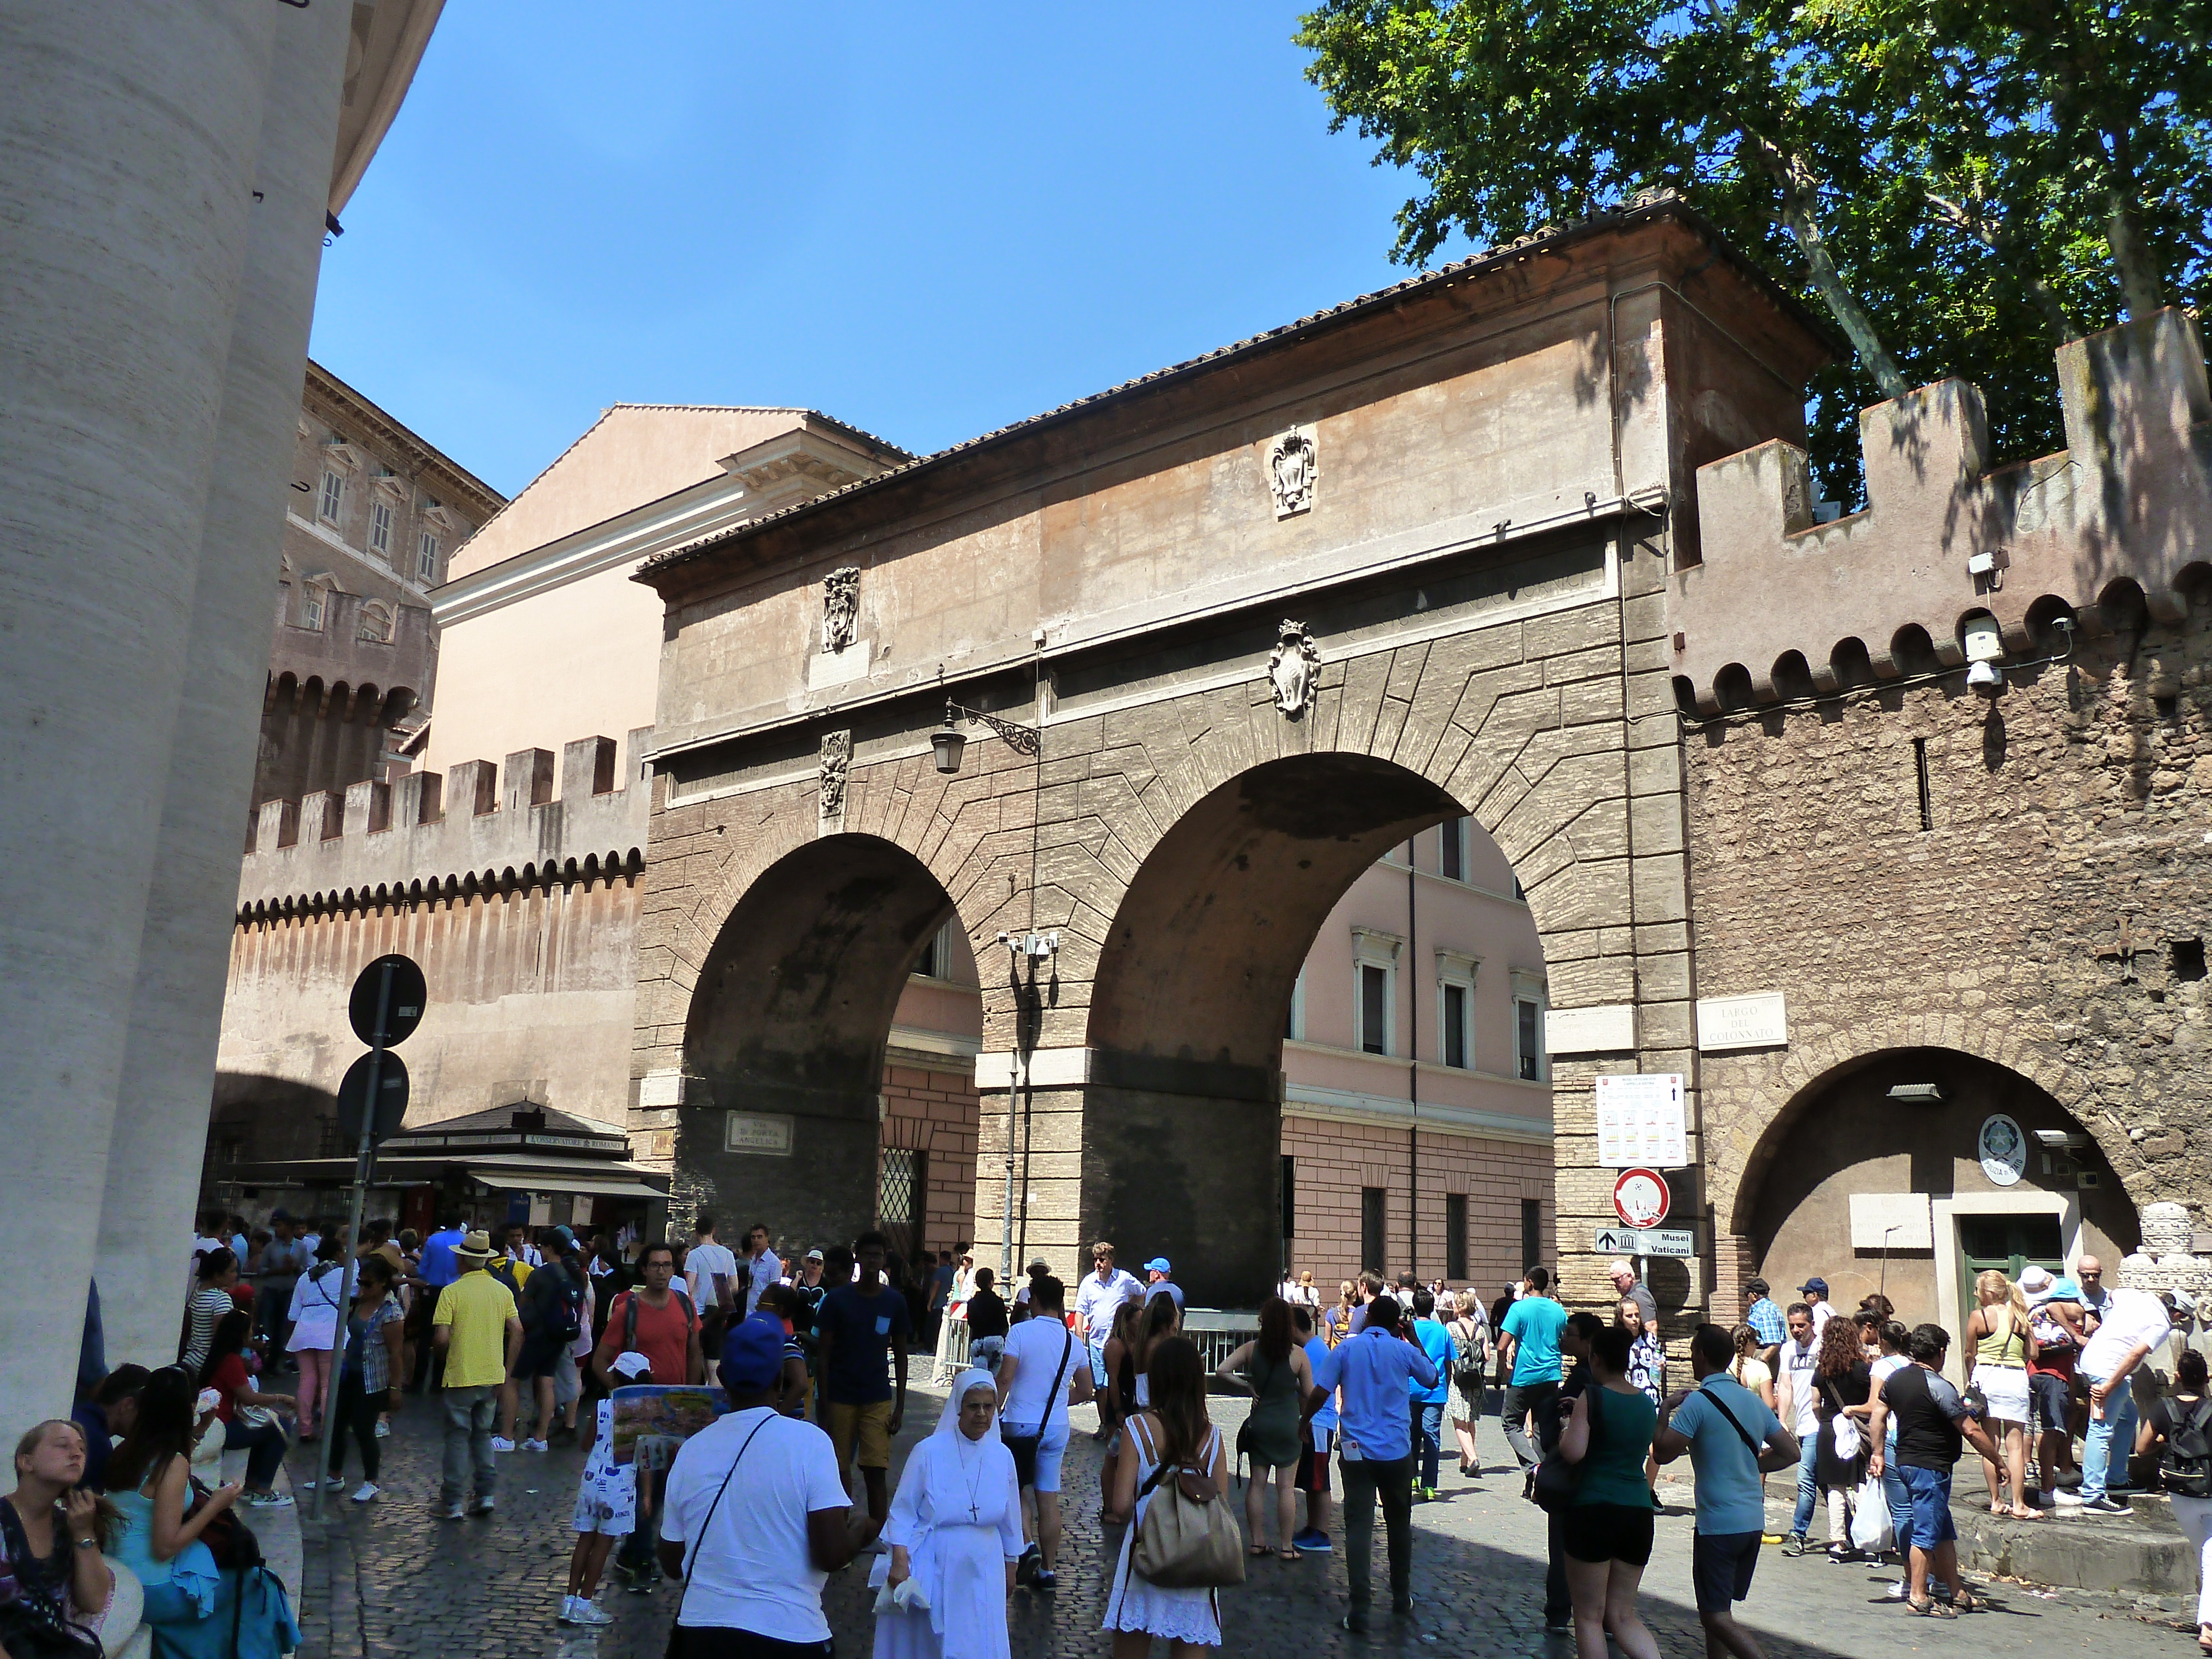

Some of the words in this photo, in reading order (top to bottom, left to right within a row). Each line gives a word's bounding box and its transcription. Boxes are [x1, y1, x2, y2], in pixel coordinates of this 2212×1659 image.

[1722, 1006, 1757, 1018] LARGO
[1731, 1019, 1749, 1028] DEL
[1709, 1028, 1773, 1041] COLONNATO
[1984, 1161, 2003, 1176] POLIZIA
[2008, 1159, 2023, 1173] STATO
[1651, 1245, 1689, 1254] Vaticani
